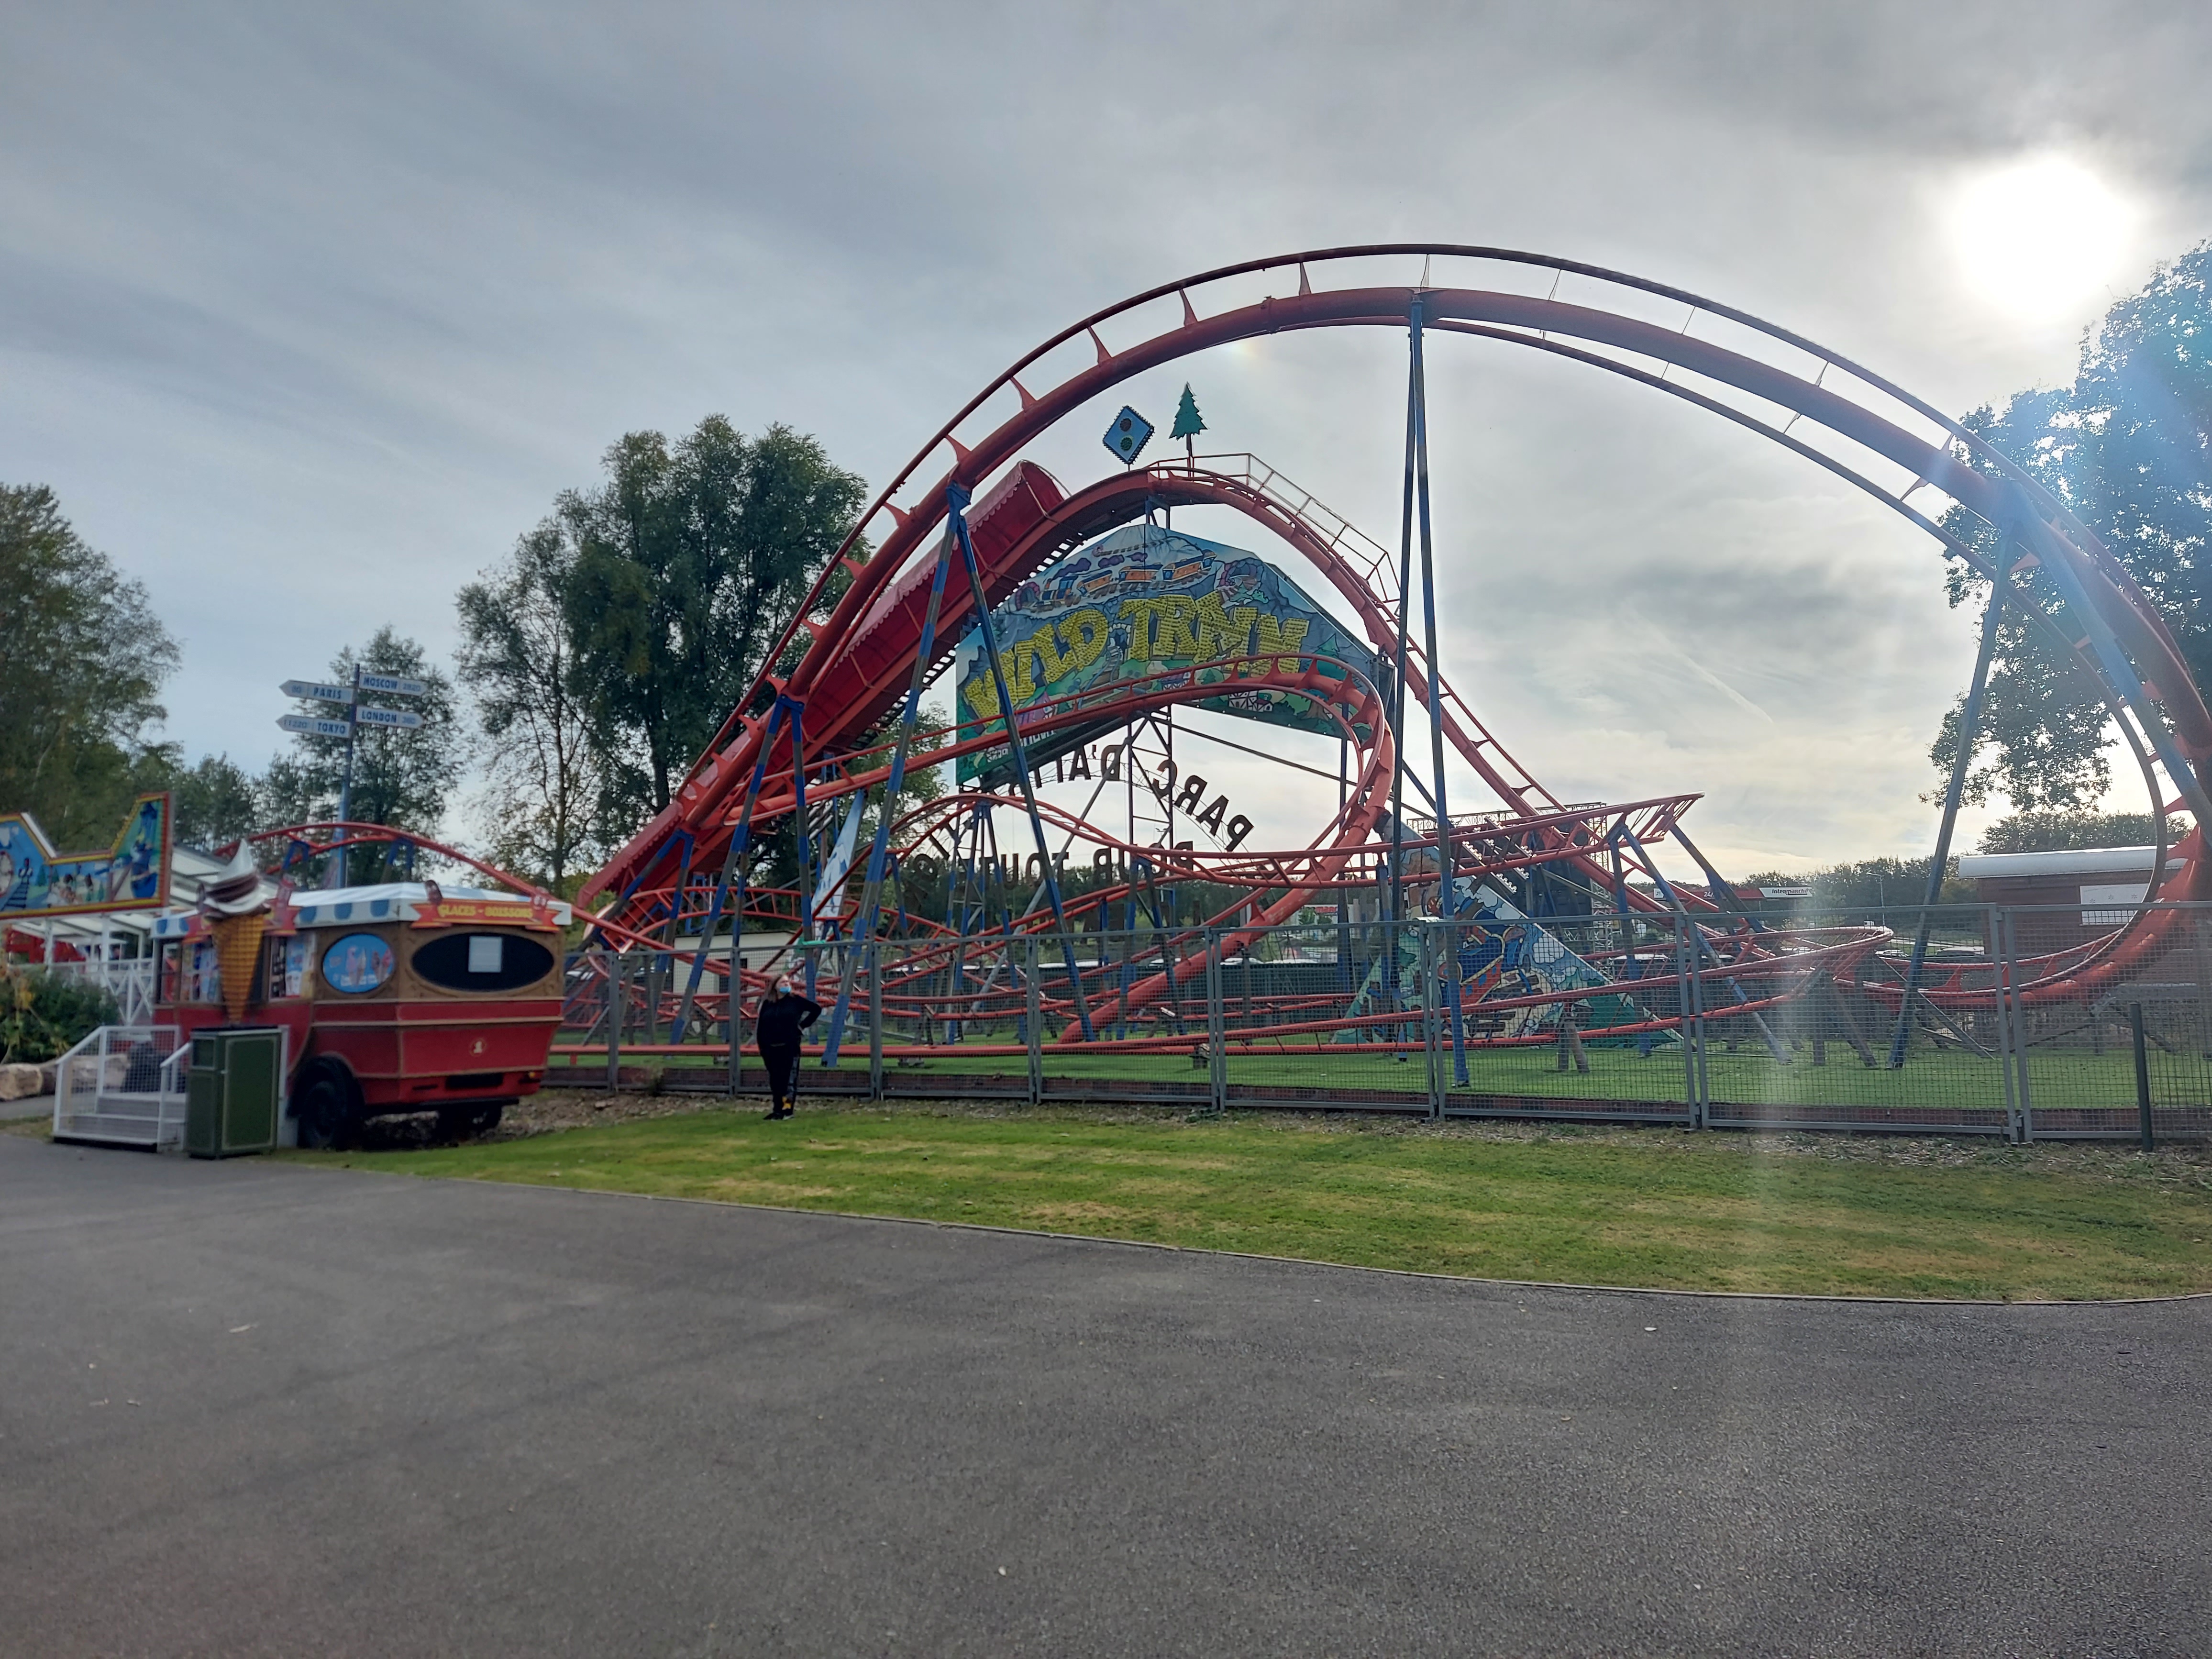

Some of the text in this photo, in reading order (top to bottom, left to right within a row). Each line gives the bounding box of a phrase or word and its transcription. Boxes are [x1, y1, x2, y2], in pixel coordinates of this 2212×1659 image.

[964, 590, 1310, 725] WILD TRAIN
[363, 676, 398, 689] MOSCOW
[313, 686, 342, 699] PARIS
[361, 710, 397, 723] LONDON
[317, 721, 346, 734] TOKYO
